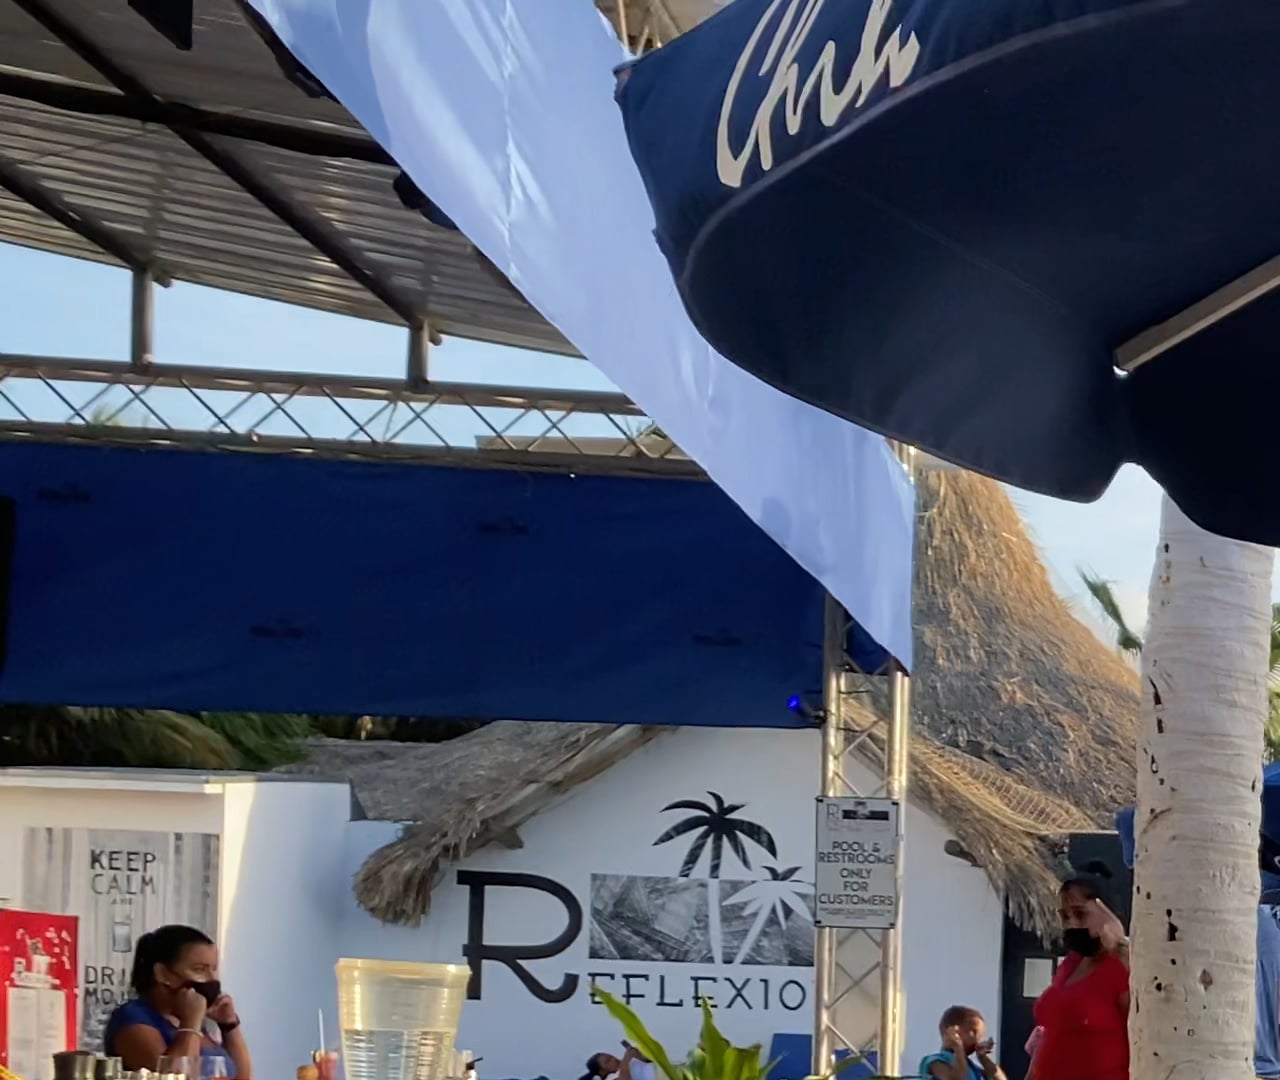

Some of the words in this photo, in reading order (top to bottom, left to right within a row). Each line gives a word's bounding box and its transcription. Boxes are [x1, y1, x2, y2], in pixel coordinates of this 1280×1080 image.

[832, 841, 868, 853] POOL
[90, 849, 156, 873] KEEP
[818, 851, 895, 865] RESTROOMS
[840, 867, 872, 879] ONLY
[91, 873, 157, 895] CALM
[843, 880, 869, 892] FOR
[818, 893, 894, 906] CUSTOMERS
